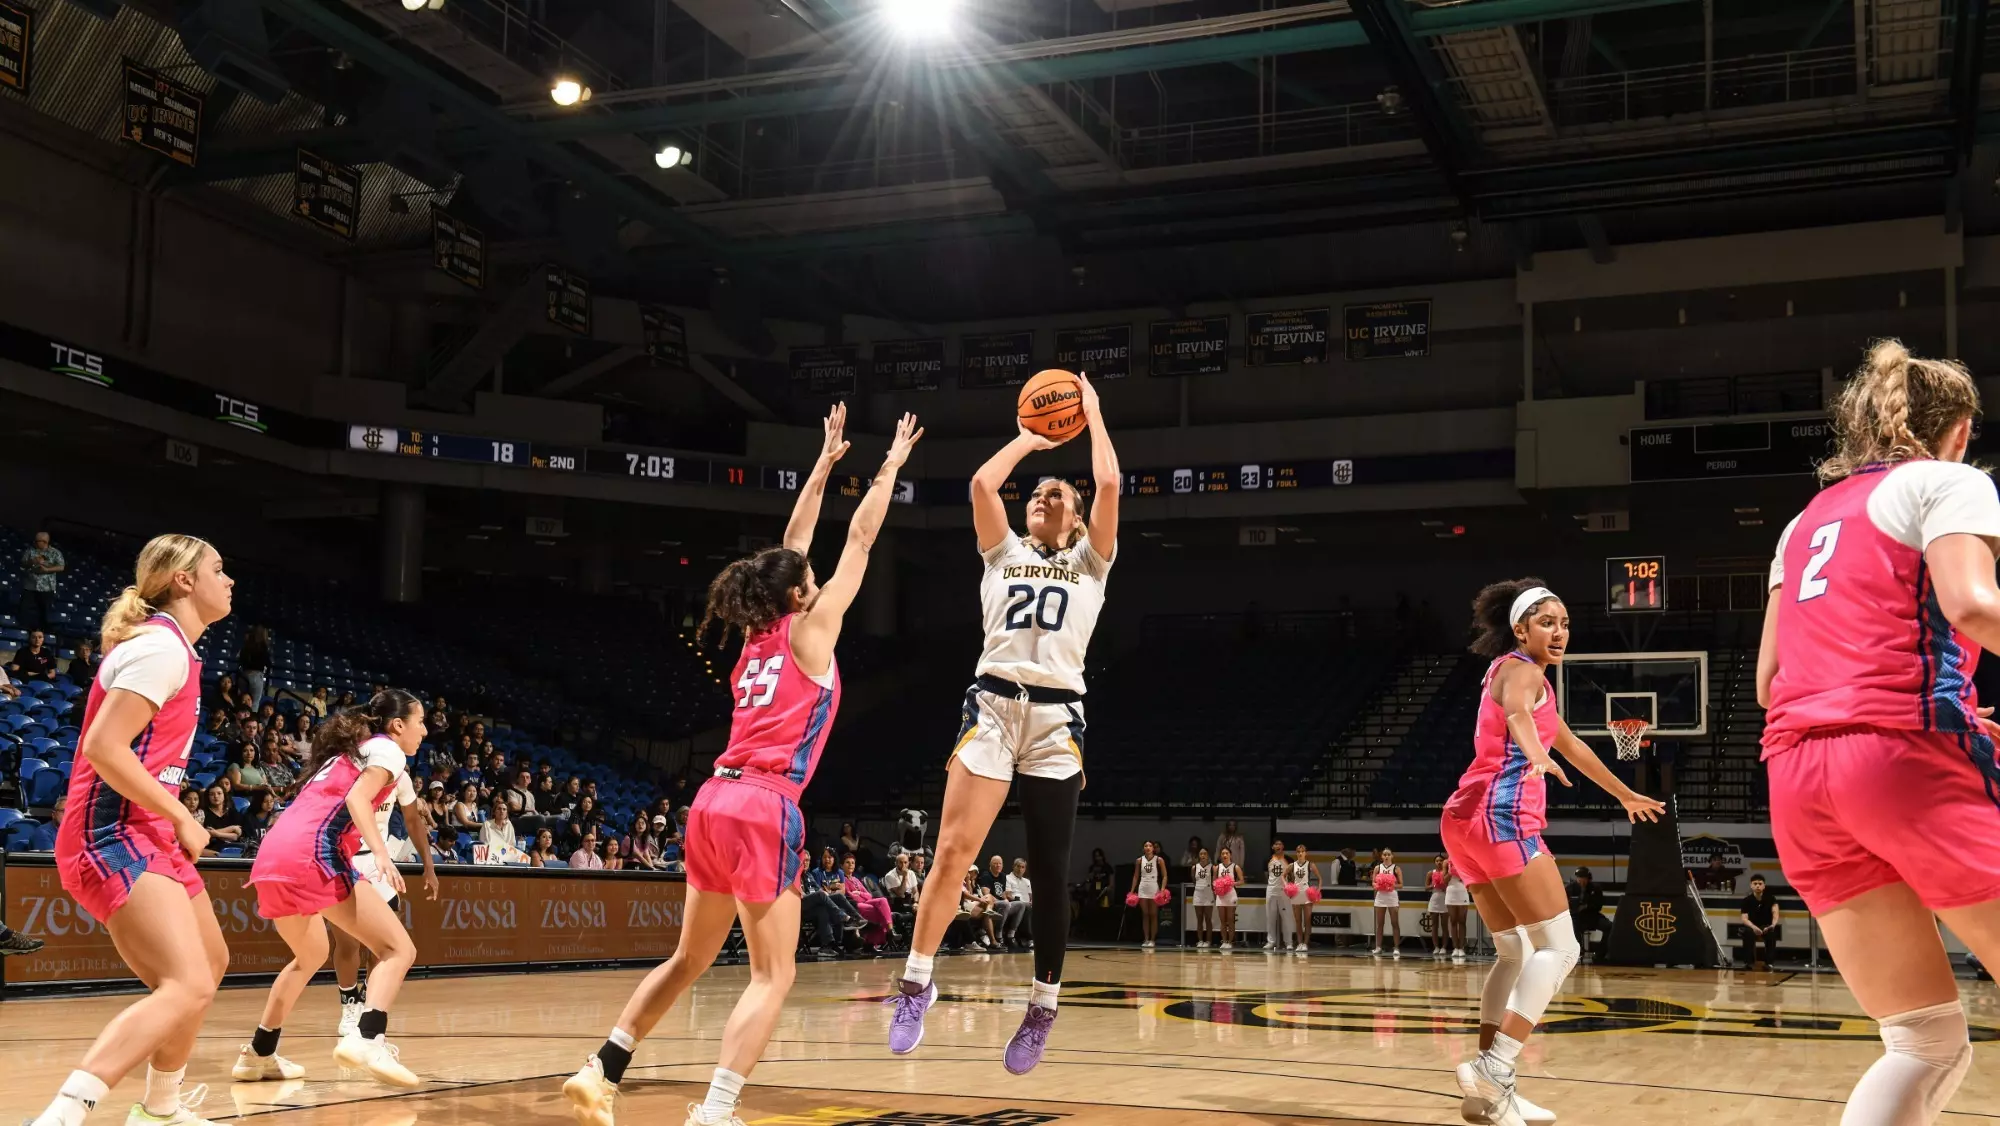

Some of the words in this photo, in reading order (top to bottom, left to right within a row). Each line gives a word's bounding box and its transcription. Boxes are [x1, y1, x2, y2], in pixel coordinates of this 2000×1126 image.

[1250, 334, 1268, 346] UC
[1274, 331, 1325, 344] IRVINE
[1348, 327, 1369, 339] UC
[1374, 324, 1426, 338] IRVINE
[1058, 351, 1076, 363] UC
[1081, 346, 1127, 361] IRVINE
[1154, 343, 1172, 355] UC
[1176, 340, 1224, 353] IRVINE
[50, 342, 103, 375] TCS
[984, 353, 1028, 367] IRVINE
[810, 366, 854, 378] IRVINE
[875, 362, 892, 374] UC
[896, 360, 940, 374] IRVINE
[1031, 390, 1080, 410] Wilson
[215, 394, 259, 423] TCS
[411, 431, 422, 443] TO:
[432, 435, 438, 444] 4
[1791, 425, 1830, 437] GUEST
[1640, 433, 1672, 446] HOME
[172, 443, 192, 462] 106
[400, 442, 422, 455] Fouls:
[432, 447, 438, 456] 0
[492, 442, 514, 463] 18
[532, 456, 547, 468] Per:
[550, 456, 575, 470] 2ND
[626, 453, 674, 478] 7:03
[1706, 461, 1737, 471] PERIOD
[729, 467, 743, 484] 11
[777, 470, 797, 490] 13
[1212, 472, 1225, 480] PTS
[1241, 472, 1259, 486] 23
[1281, 469, 1294, 477] PTS
[1174, 476, 1192, 490] 20
[1207, 483, 1229, 491] FOULS
[1275, 480, 1297, 488] FOULS
[1601, 515, 1615, 528] 111
[1248, 529, 1266, 543] 110
[1796, 519, 1843, 603] 2
[1003, 566, 1021, 580] UC
[1023, 565, 1079, 585] IRVINE
[1624, 561, 1659, 578] 7:02
[1629, 579, 1655, 606] 11
[1005, 584, 1069, 632] 20
[737, 654, 784, 708] 55
[451, 882, 507, 893] HOTEL
[550, 884, 595, 895] HOTEL
[635, 886, 677, 895] HOTEL
[440, 898, 517, 930] zessa
[540, 899, 607, 928] zessa
[627, 900, 684, 928] zessa
[34, 957, 108, 973] DOUBLETREE
